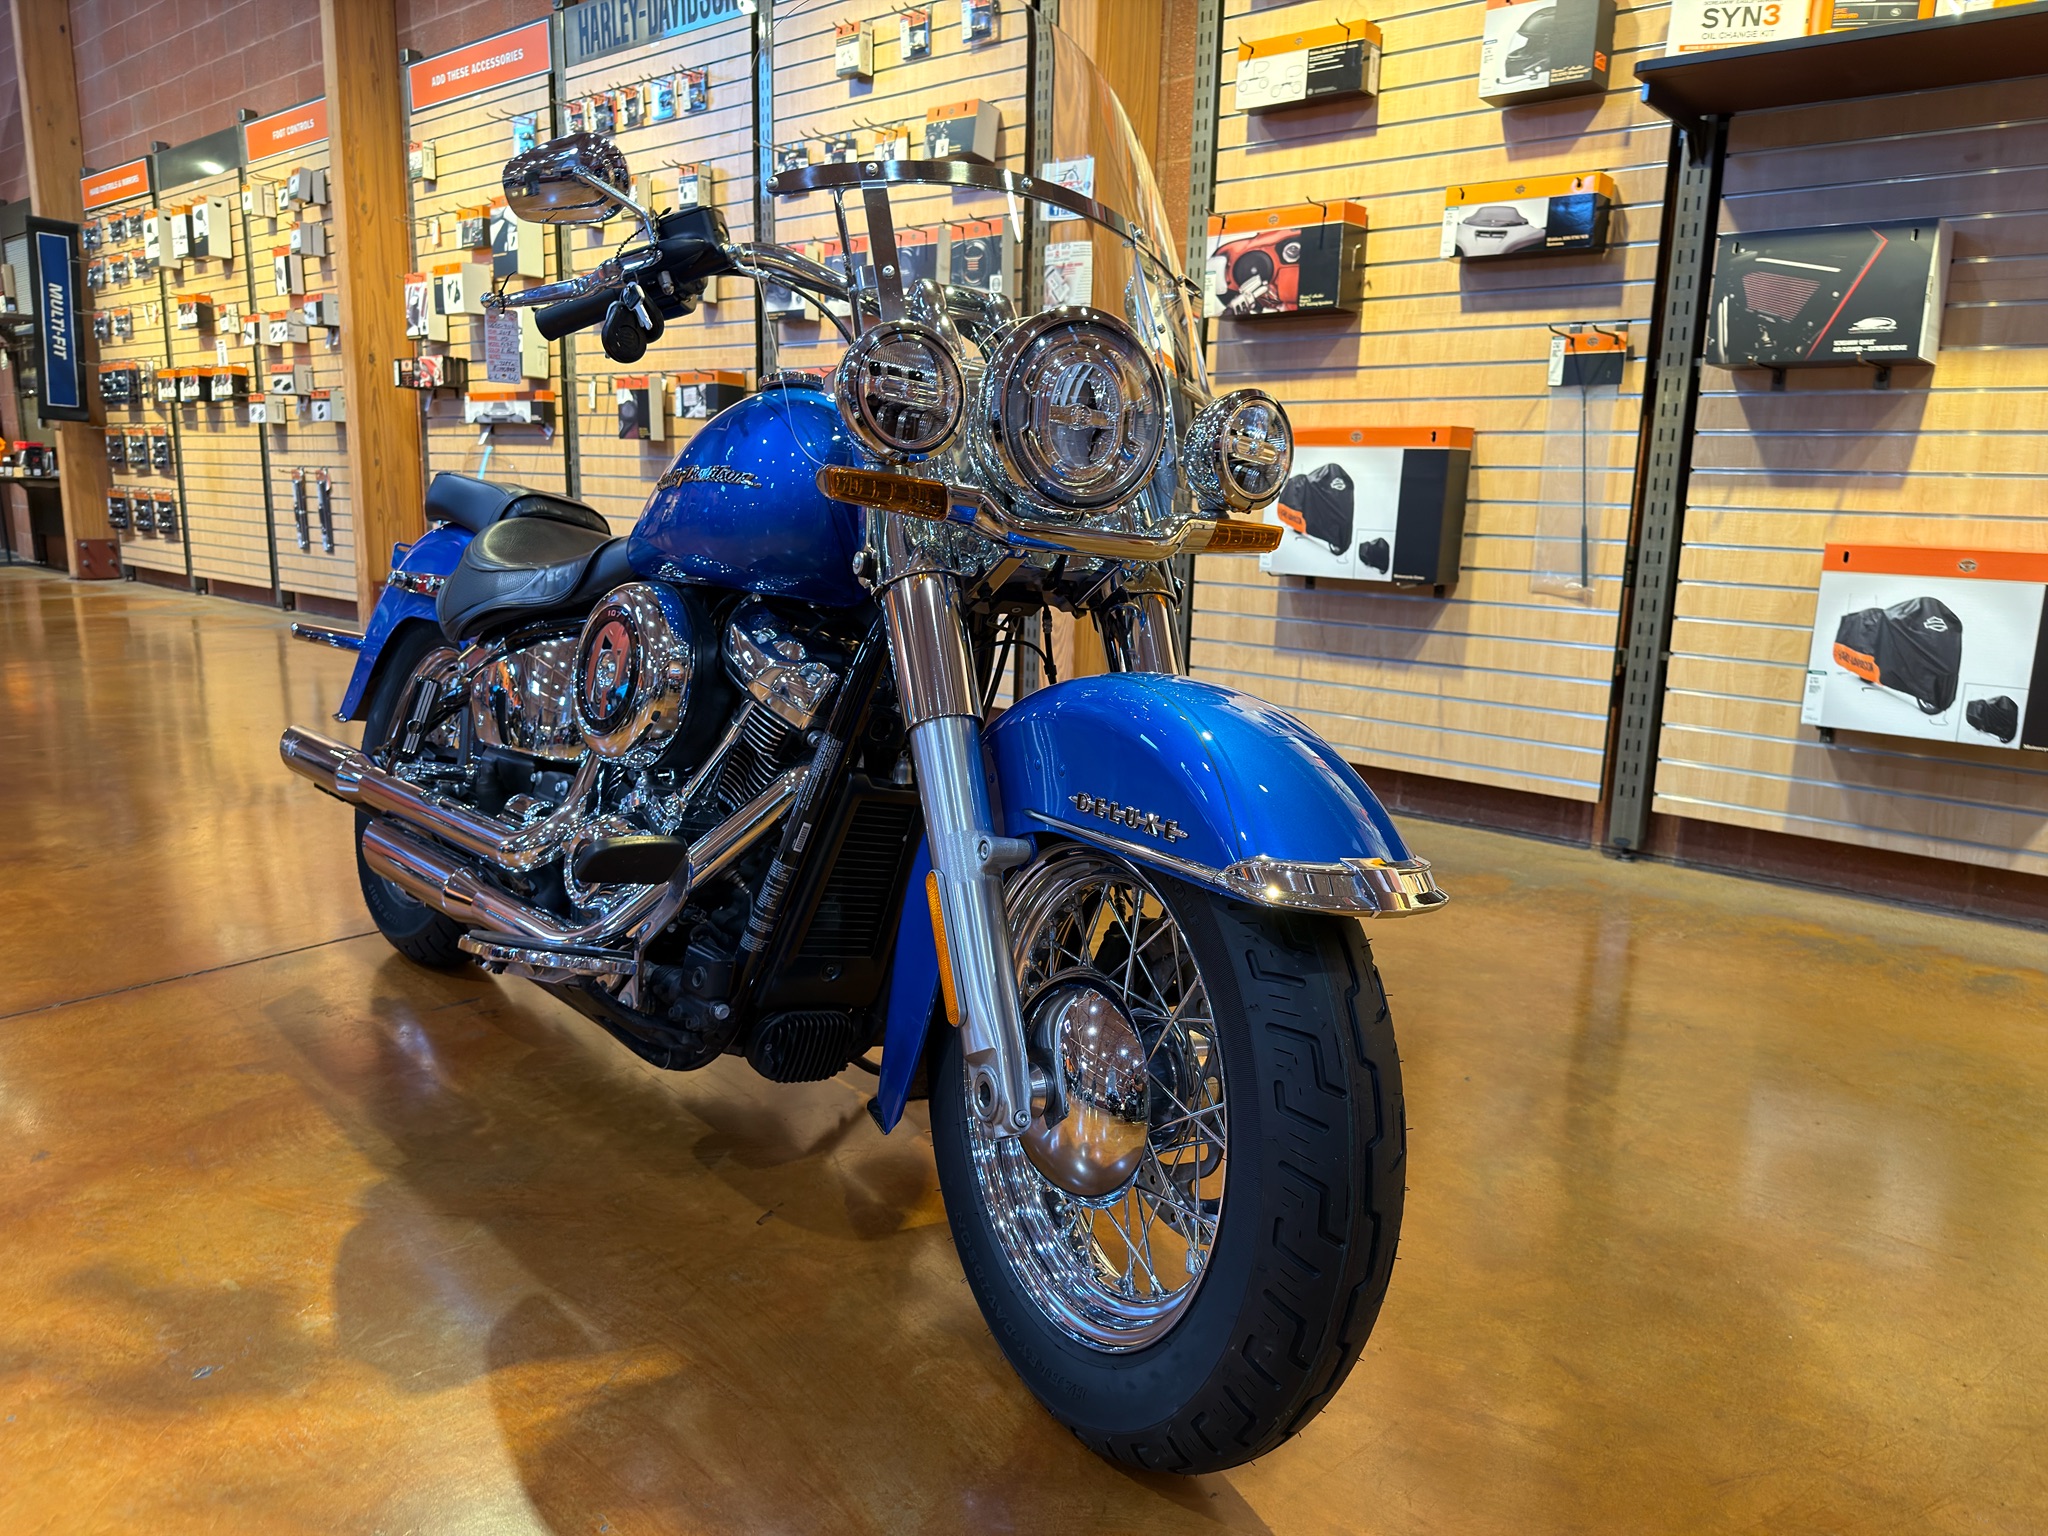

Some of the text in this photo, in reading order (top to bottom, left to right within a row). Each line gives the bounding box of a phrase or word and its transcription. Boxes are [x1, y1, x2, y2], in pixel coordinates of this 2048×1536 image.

[1701, 3, 1781, 29] SYN3
[1701, 32, 1716, 40] OIL
[1718, 30, 1758, 40] CHANGE
[431, 48, 524, 88] ADD THESE ACCESSORIES
[272, 118, 315, 140] FOOT CONTROLS
[48, 283, 67, 360] MULTI-FIT
[607, 609, 621, 618] 107
[1075, 791, 1179, 844] DELUXE
